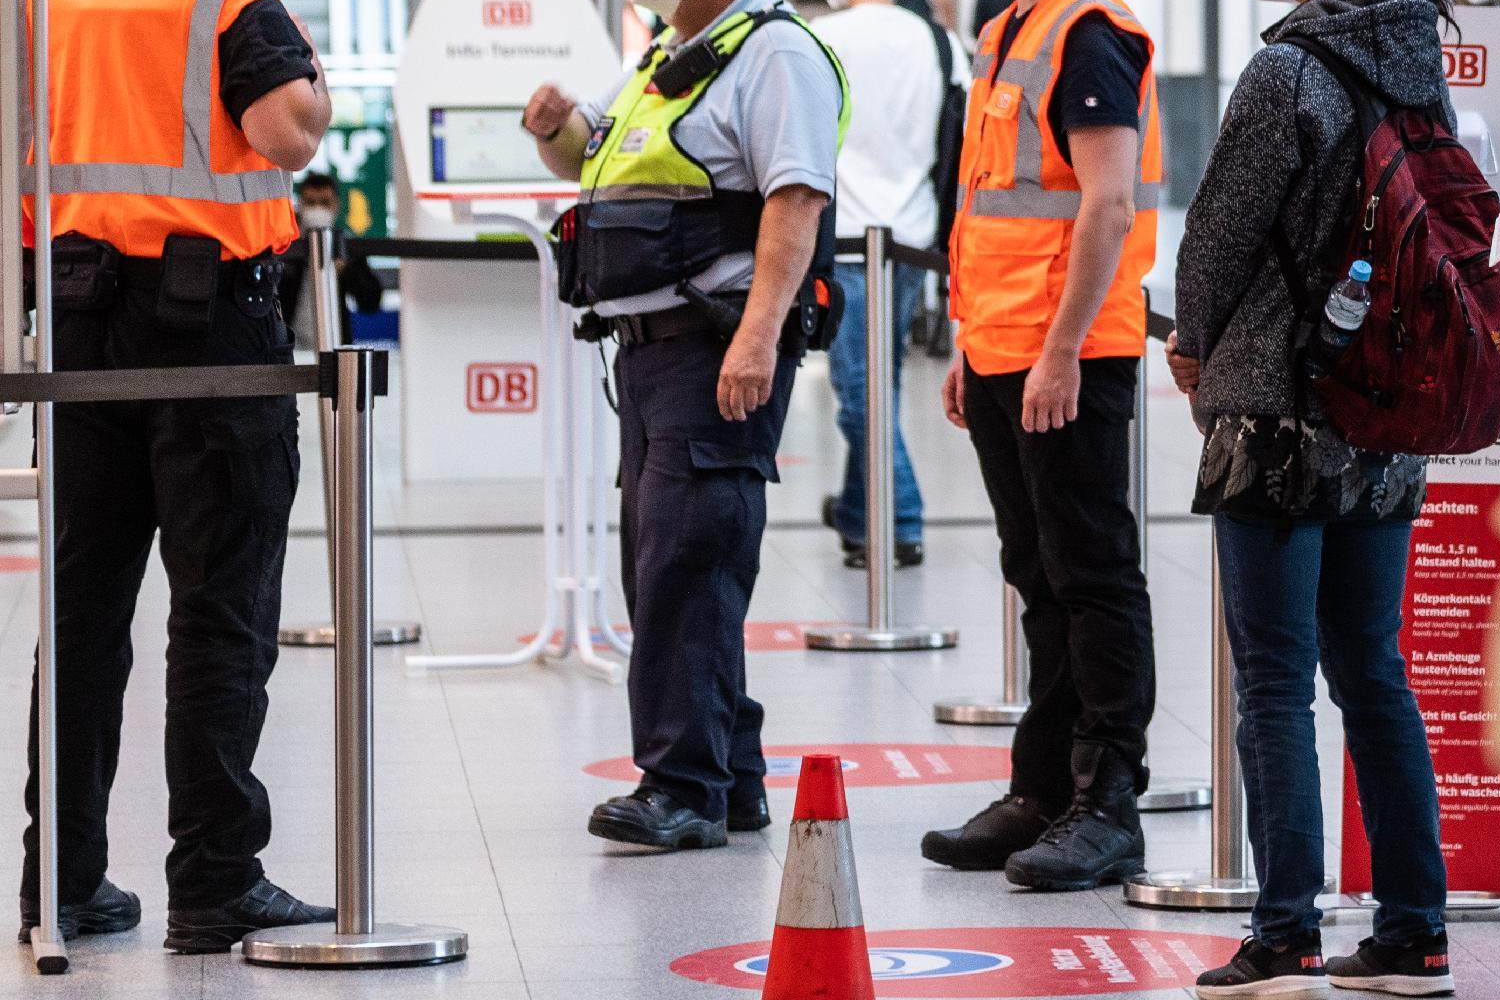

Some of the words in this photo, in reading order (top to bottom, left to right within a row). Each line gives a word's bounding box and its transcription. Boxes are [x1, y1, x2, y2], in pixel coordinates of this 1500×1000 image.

[475, 371, 529, 404] DB
[1459, 458, 1482, 468] your
[1415, 543, 1446, 554] Mind.
[1448, 544, 1465, 555] 1,5
[1467, 546, 1478, 554] m
[1415, 557, 1459, 567] Abstand
[1461, 557, 1497, 568] halten
[1413, 592, 1492, 606] Körperkontakt
[1413, 607, 1470, 617] vermeiden
[1411, 651, 1423, 662] In
[1426, 651, 1481, 664] Armbeuge
[1411, 664, 1486, 676] husten/niesen
[1441, 710, 1457, 721] ins
[1459, 710, 1498, 722] Gesicht
[1445, 773, 1479, 786] häufig
